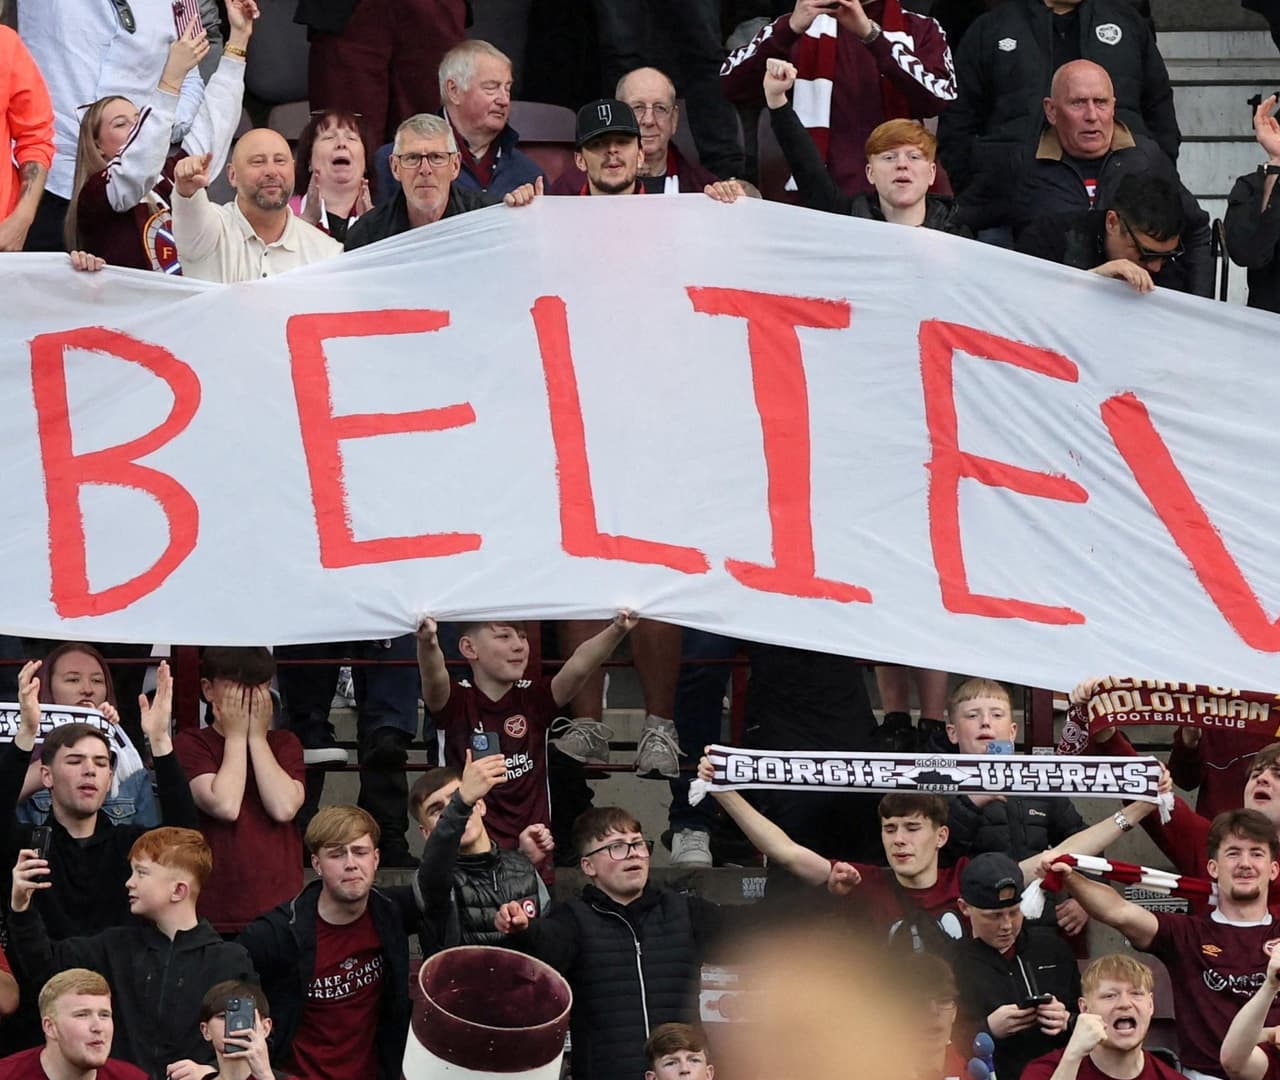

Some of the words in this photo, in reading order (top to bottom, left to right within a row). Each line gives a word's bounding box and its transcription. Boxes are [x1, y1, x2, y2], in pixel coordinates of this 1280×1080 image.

[1088, 690, 1270, 722] MIDLOTHIAN
[1107, 712, 1195, 724] FOOTBALL
[1202, 716, 1246, 729] CLUB
[726, 755, 900, 788] GORGIE
[976, 761, 1150, 793] ULTRAS
[308, 975, 342, 988] AKE
[346, 955, 384, 981] GORG
[356, 966, 383, 989] AGA
